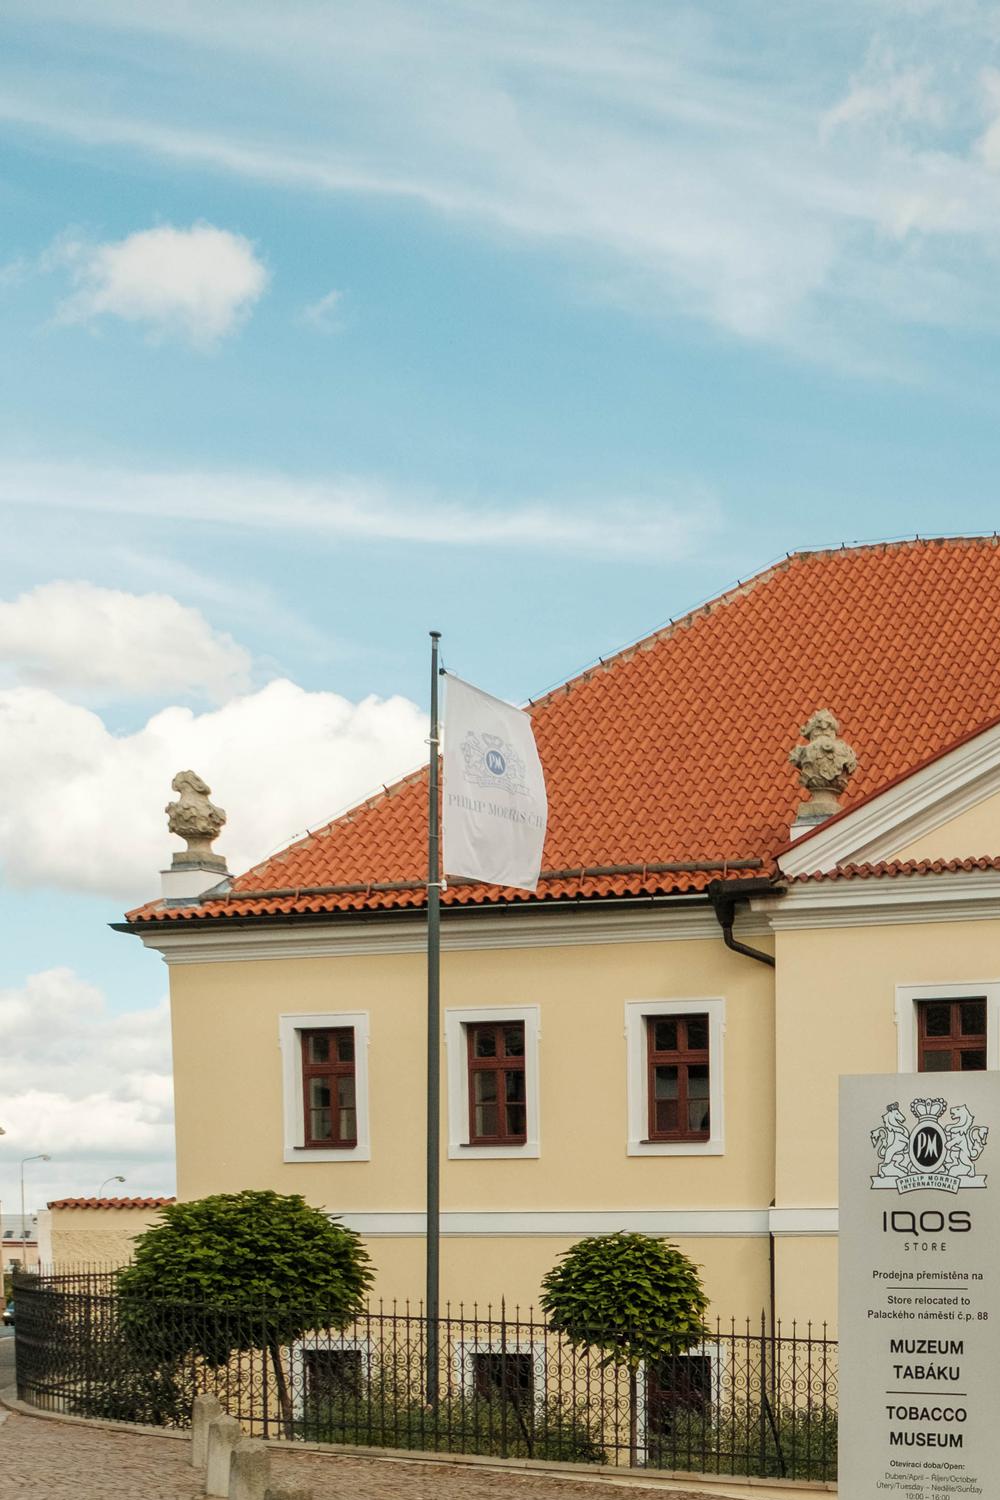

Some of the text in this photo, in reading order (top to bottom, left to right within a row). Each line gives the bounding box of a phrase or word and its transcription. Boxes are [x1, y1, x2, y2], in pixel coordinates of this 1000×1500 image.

[448, 793, 486, 812] PHILIP
[488, 802, 526, 824] MORRIS
[917, 1131, 938, 1159] PM
[900, 1175, 957, 1185] PHILIP MORRIS
[901, 1181, 956, 1190] INTERNATIONAL
[883, 1211, 972, 1236] IQOS
[904, 1242, 947, 1251] STORE
[872, 1270, 914, 1281] Prodejna
[887, 1296, 971, 1305] Store relocated to
[867, 1310, 915, 1320] Palackého
[918, 1310, 955, 1320] náměstí
[977, 1312, 989, 1320] 88
[890, 1339, 964, 1355] MUZEUM
[893, 1362, 960, 1381] TABÁKU
[886, 1405, 967, 1422] TOBACCO
[889, 1431, 963, 1448] MUSEUM
